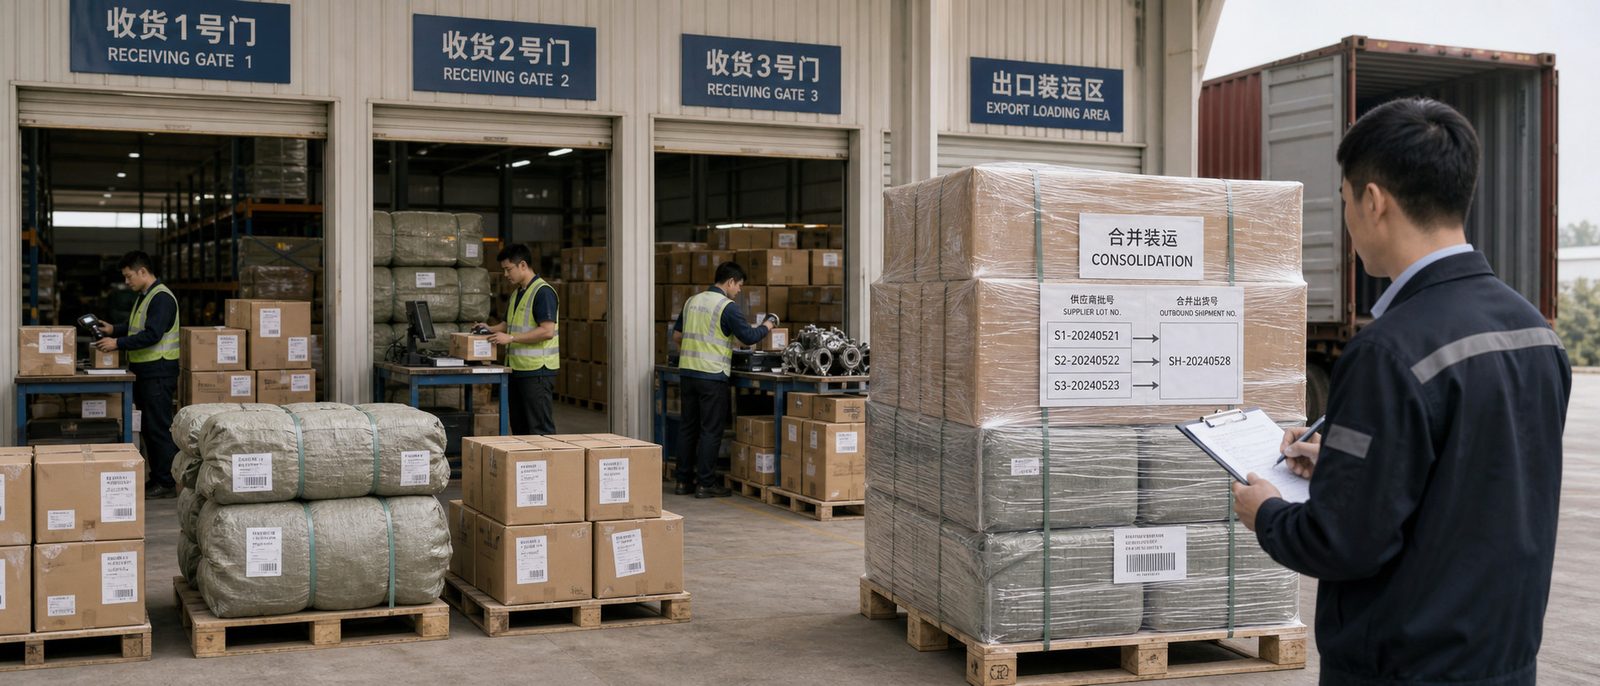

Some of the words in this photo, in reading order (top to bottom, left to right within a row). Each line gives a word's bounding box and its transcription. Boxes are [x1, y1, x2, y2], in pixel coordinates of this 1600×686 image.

[106, 6, 256, 47] 收货1号门
[442, 30, 570, 66] 收货2号门
[108, 47, 190, 65] RECEIVING
[195, 53, 234, 68] GATE
[244, 55, 252, 69] 1
[706, 48, 820, 82] 收货3号门
[443, 67, 515, 84] RECEIVING
[519, 72, 554, 86] GATE
[560, 74, 570, 87] 2
[992, 70, 1104, 102] 出口装运区
[707, 83, 771, 99] RECEIVING
[774, 87, 805, 101] GATE
[810, 90, 818, 102] 3
[986, 102, 1030, 116] EXPORT
[1033, 105, 1080, 120] LOADING
[1082, 108, 1111, 121] AREA
[1108, 227, 1178, 248] 合并装运
[1091, 254, 1193, 268] CONSOLIDATION
[1070, 294, 1114, 305] 供应商批号
[1054, 330, 1119, 341] S1-20240521
[1054, 355, 1120, 366] S2-20240522
[1168, 356, 1231, 366] SH-20240528
[1054, 380, 1120, 391] S3-20240523
